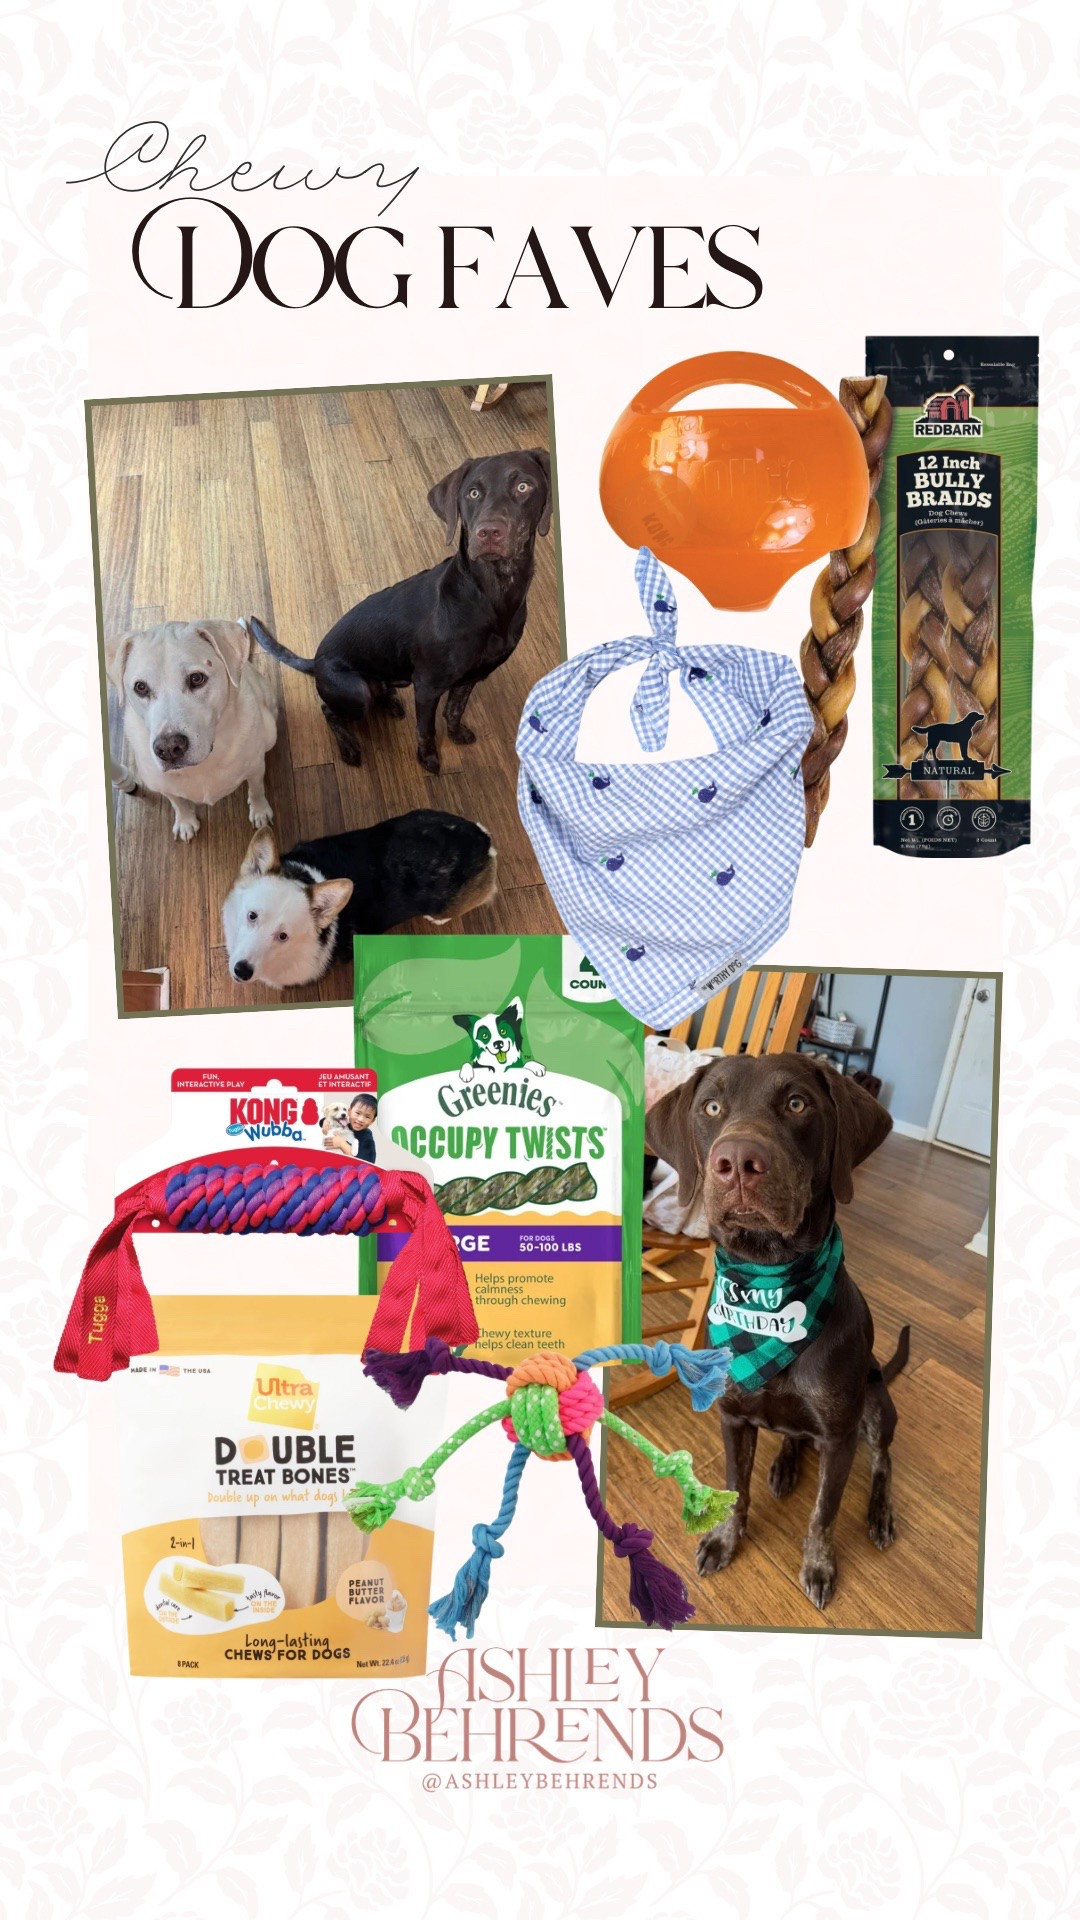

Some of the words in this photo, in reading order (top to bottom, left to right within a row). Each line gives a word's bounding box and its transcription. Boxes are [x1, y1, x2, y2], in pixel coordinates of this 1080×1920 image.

[915, 424, 982, 436] REDBARN
[917, 456, 939, 470] 12
[942, 456, 981, 470] Inch
[914, 472, 986, 490] BULLY
[905, 491, 992, 509] BRAIDS
[944, 509, 968, 517] Chews
[923, 766, 975, 775] NATURAL
[727, 958, 743, 974] DOG
[569, 979, 607, 990] COUN
[202, 1073, 220, 1081] FUN,
[437, 1077, 557, 1118] Greenies
[230, 1097, 298, 1126] KONG
[243, 1120, 303, 1142] Wubba
[391, 1125, 498, 1160] OCCUPY
[505, 1125, 605, 1160] TWISTS
[519, 1242, 559, 1252] 50-100
[561, 1242, 582, 1252] LBS
[475, 1273, 505, 1285] Helps
[507, 1274, 554, 1285] promote
[475, 1284, 524, 1294] calmness
[475, 1295, 518, 1308] through
[521, 1295, 567, 1308] chewing
[87, 1295, 110, 1345] Tugga
[513, 1329, 552, 1339] texture
[475, 1339, 503, 1351] helps
[505, 1339, 535, 1349] clean
[536, 1339, 565, 1349] teeth
[130, 1366, 148, 1374] MADE
[256, 1377, 314, 1397] Ultra
[253, 1396, 316, 1413] Chewy
[215, 1434, 356, 1466] DOUBLE
[215, 1468, 276, 1486] TREAT
[207, 1489, 243, 1503] Double
[246, 1492, 260, 1507] up
[264, 1492, 279, 1503] on
[281, 1488, 310, 1502] what
[313, 1490, 338, 1507] dogs
[170, 1536, 195, 1550] 2-in-1
[348, 1578, 385, 1588] PEANUT
[348, 1587, 385, 1597] BUTTER
[348, 1596, 385, 1605] FLAVOR
[245, 1632, 330, 1654] Long-lasting
[224, 1648, 273, 1661] CHEWS
[277, 1649, 307, 1661] FOR
[311, 1647, 351, 1660] DOGS
[177, 1660, 182, 1668] 8
[181, 1660, 199, 1669] PACK
[356, 1660, 369, 1668] Net
[369, 1659, 381, 1667] Wt.
